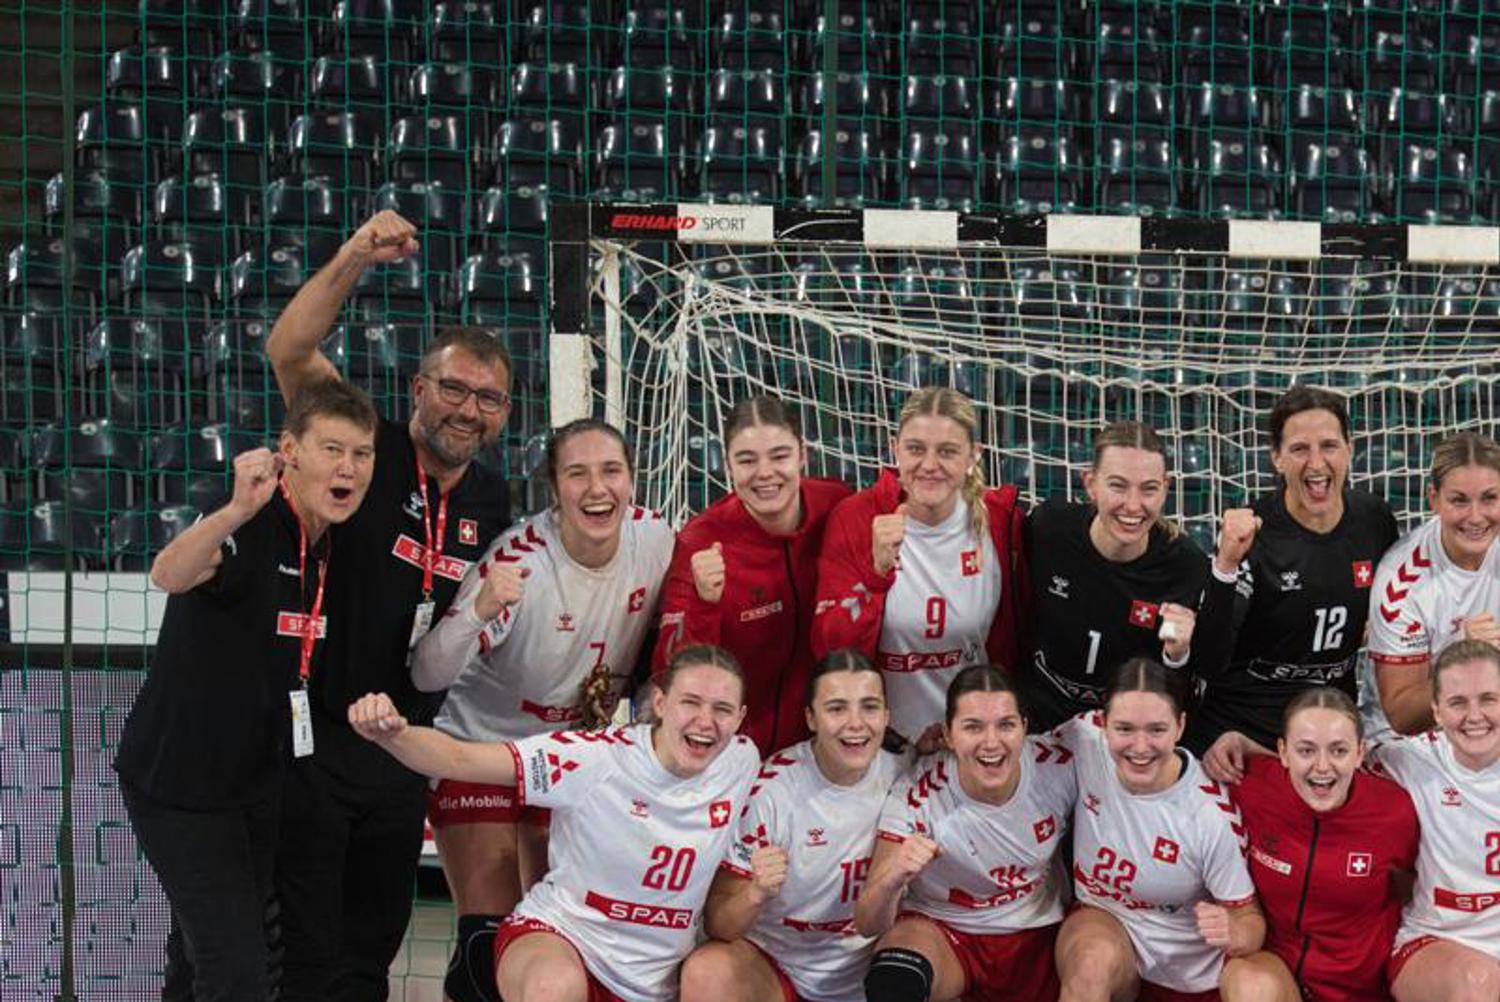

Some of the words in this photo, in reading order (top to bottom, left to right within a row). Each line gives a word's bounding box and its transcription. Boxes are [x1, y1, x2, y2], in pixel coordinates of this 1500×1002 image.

[611, 214, 697, 230] ERHARD
[702, 217, 746, 231] SPORT
[411, 546, 463, 577] SAR
[925, 596, 946, 638] 9
[1313, 606, 1347, 652] 12
[887, 653, 959, 671] SPAR
[1086, 630, 1101, 674] 1
[1272, 665, 1345, 681] SPAR
[642, 845, 696, 891] 20
[1093, 847, 1137, 899] 22
[609, 902, 690, 926] SPAR
